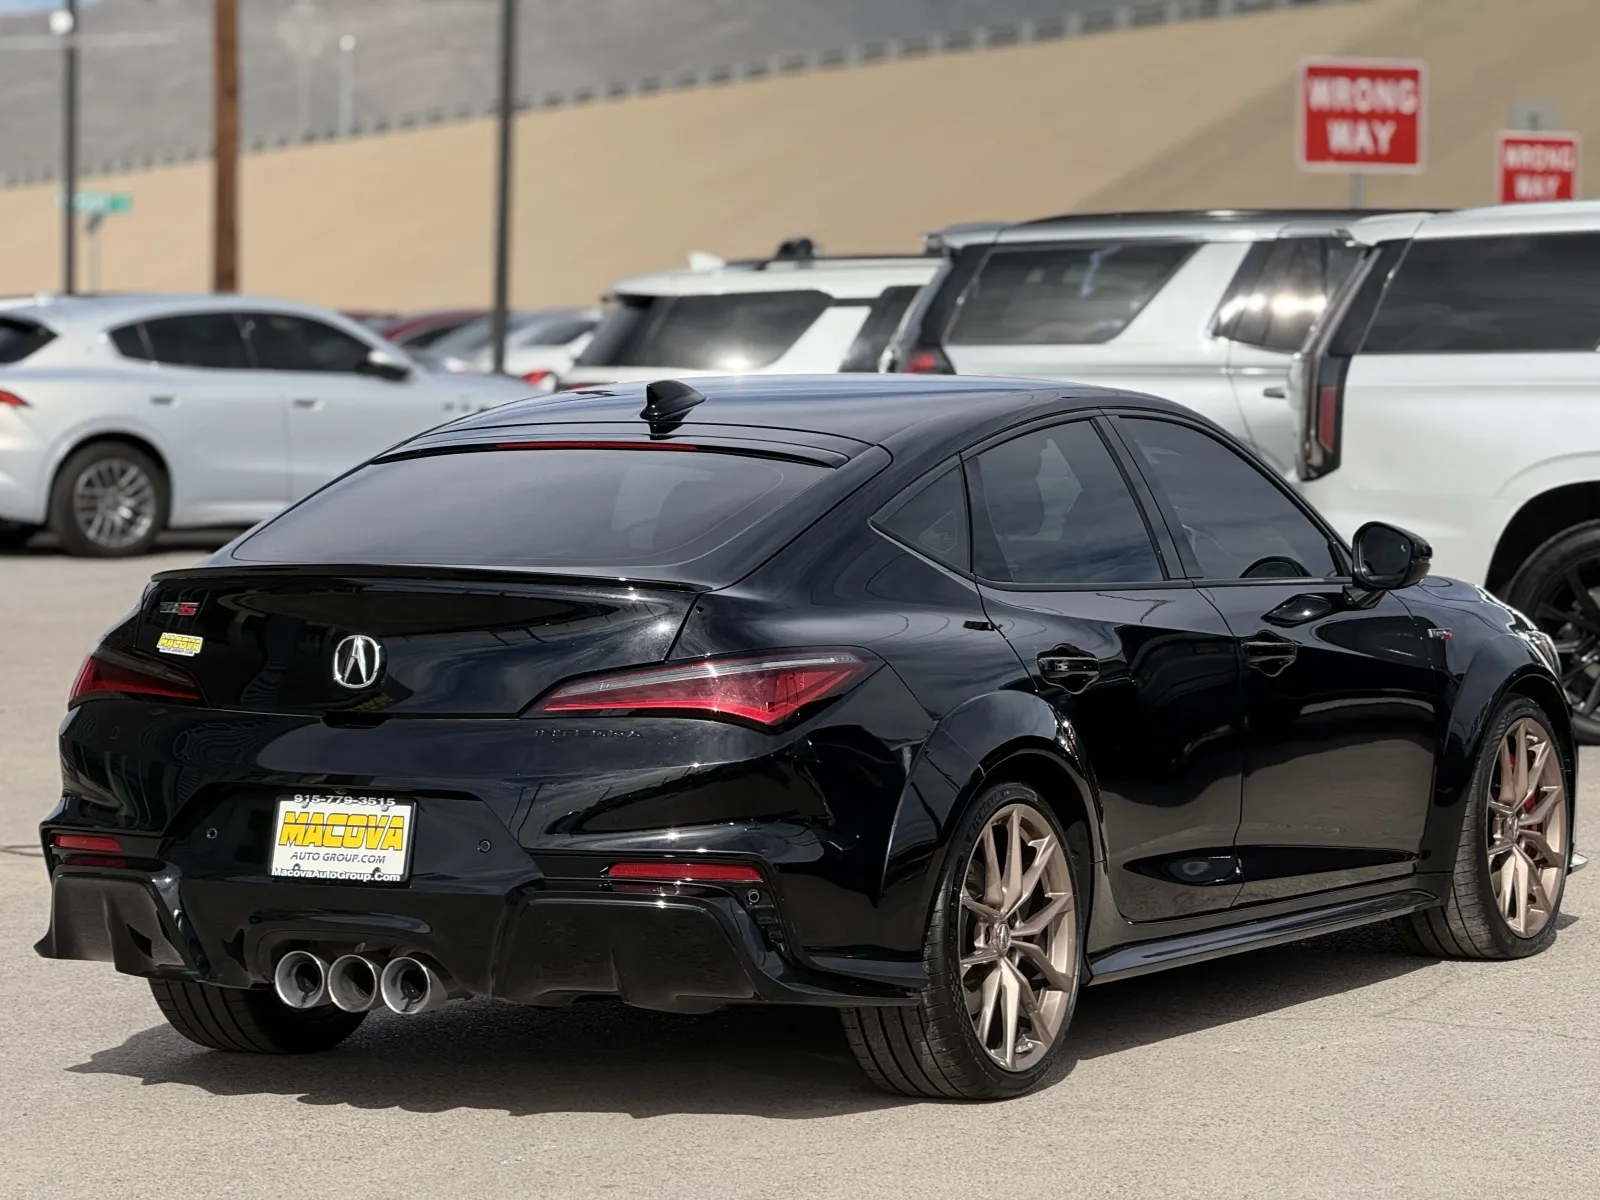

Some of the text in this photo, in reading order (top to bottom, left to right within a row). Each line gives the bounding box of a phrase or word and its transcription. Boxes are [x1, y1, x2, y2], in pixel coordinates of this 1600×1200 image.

[1308, 75, 1419, 115] WRONG
[1326, 118, 1397, 155] WAY
[1503, 143, 1576, 172] WRONG
[158, 634, 201, 651] MACOVA
[294, 794, 396, 807] 915-779-3515
[278, 810, 405, 852] MACOVA
[290, 851, 387, 864] AUTO GROUP.COM
[271, 867, 401, 882] MacovaAutoGroup.Com
